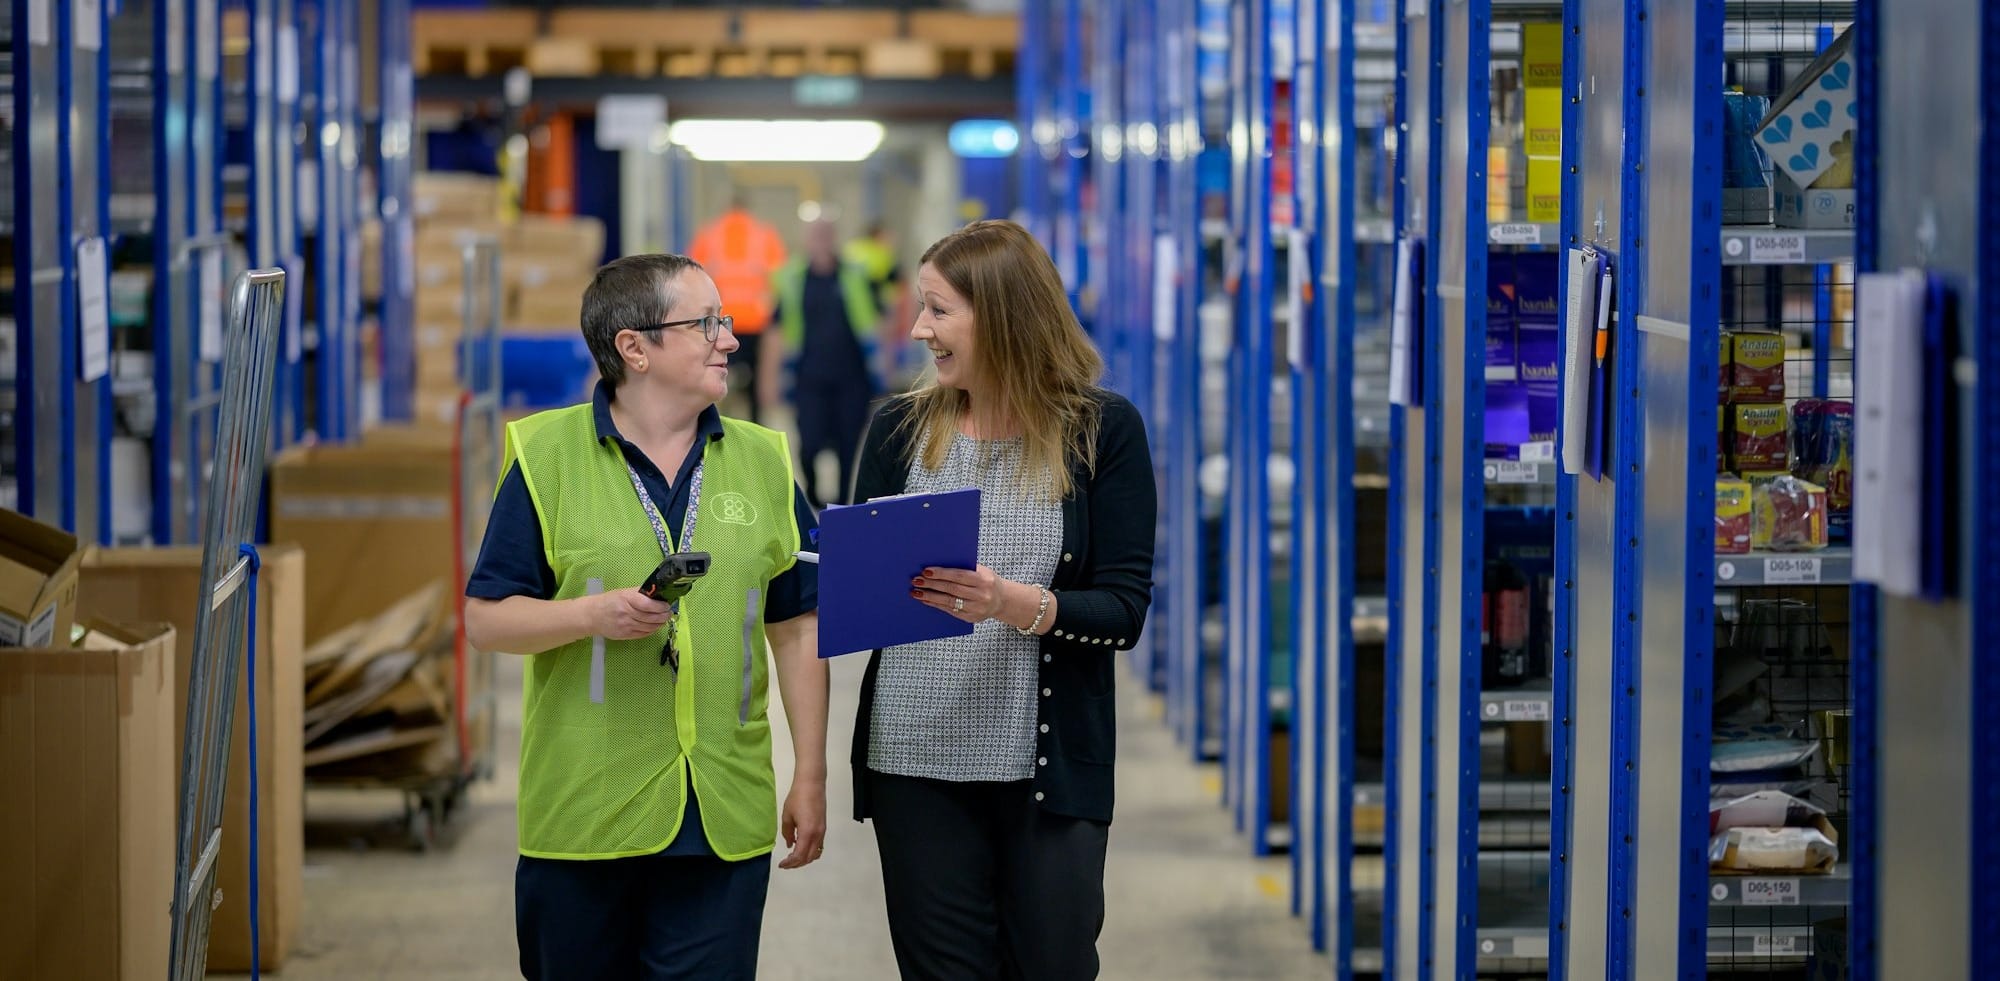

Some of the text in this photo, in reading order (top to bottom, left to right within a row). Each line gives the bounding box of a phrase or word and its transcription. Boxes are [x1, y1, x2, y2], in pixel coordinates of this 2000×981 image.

[1755, 238, 1799, 249] D05-050
[1770, 560, 1813, 572] D05-100
[1748, 882, 1792, 893] D05-150
